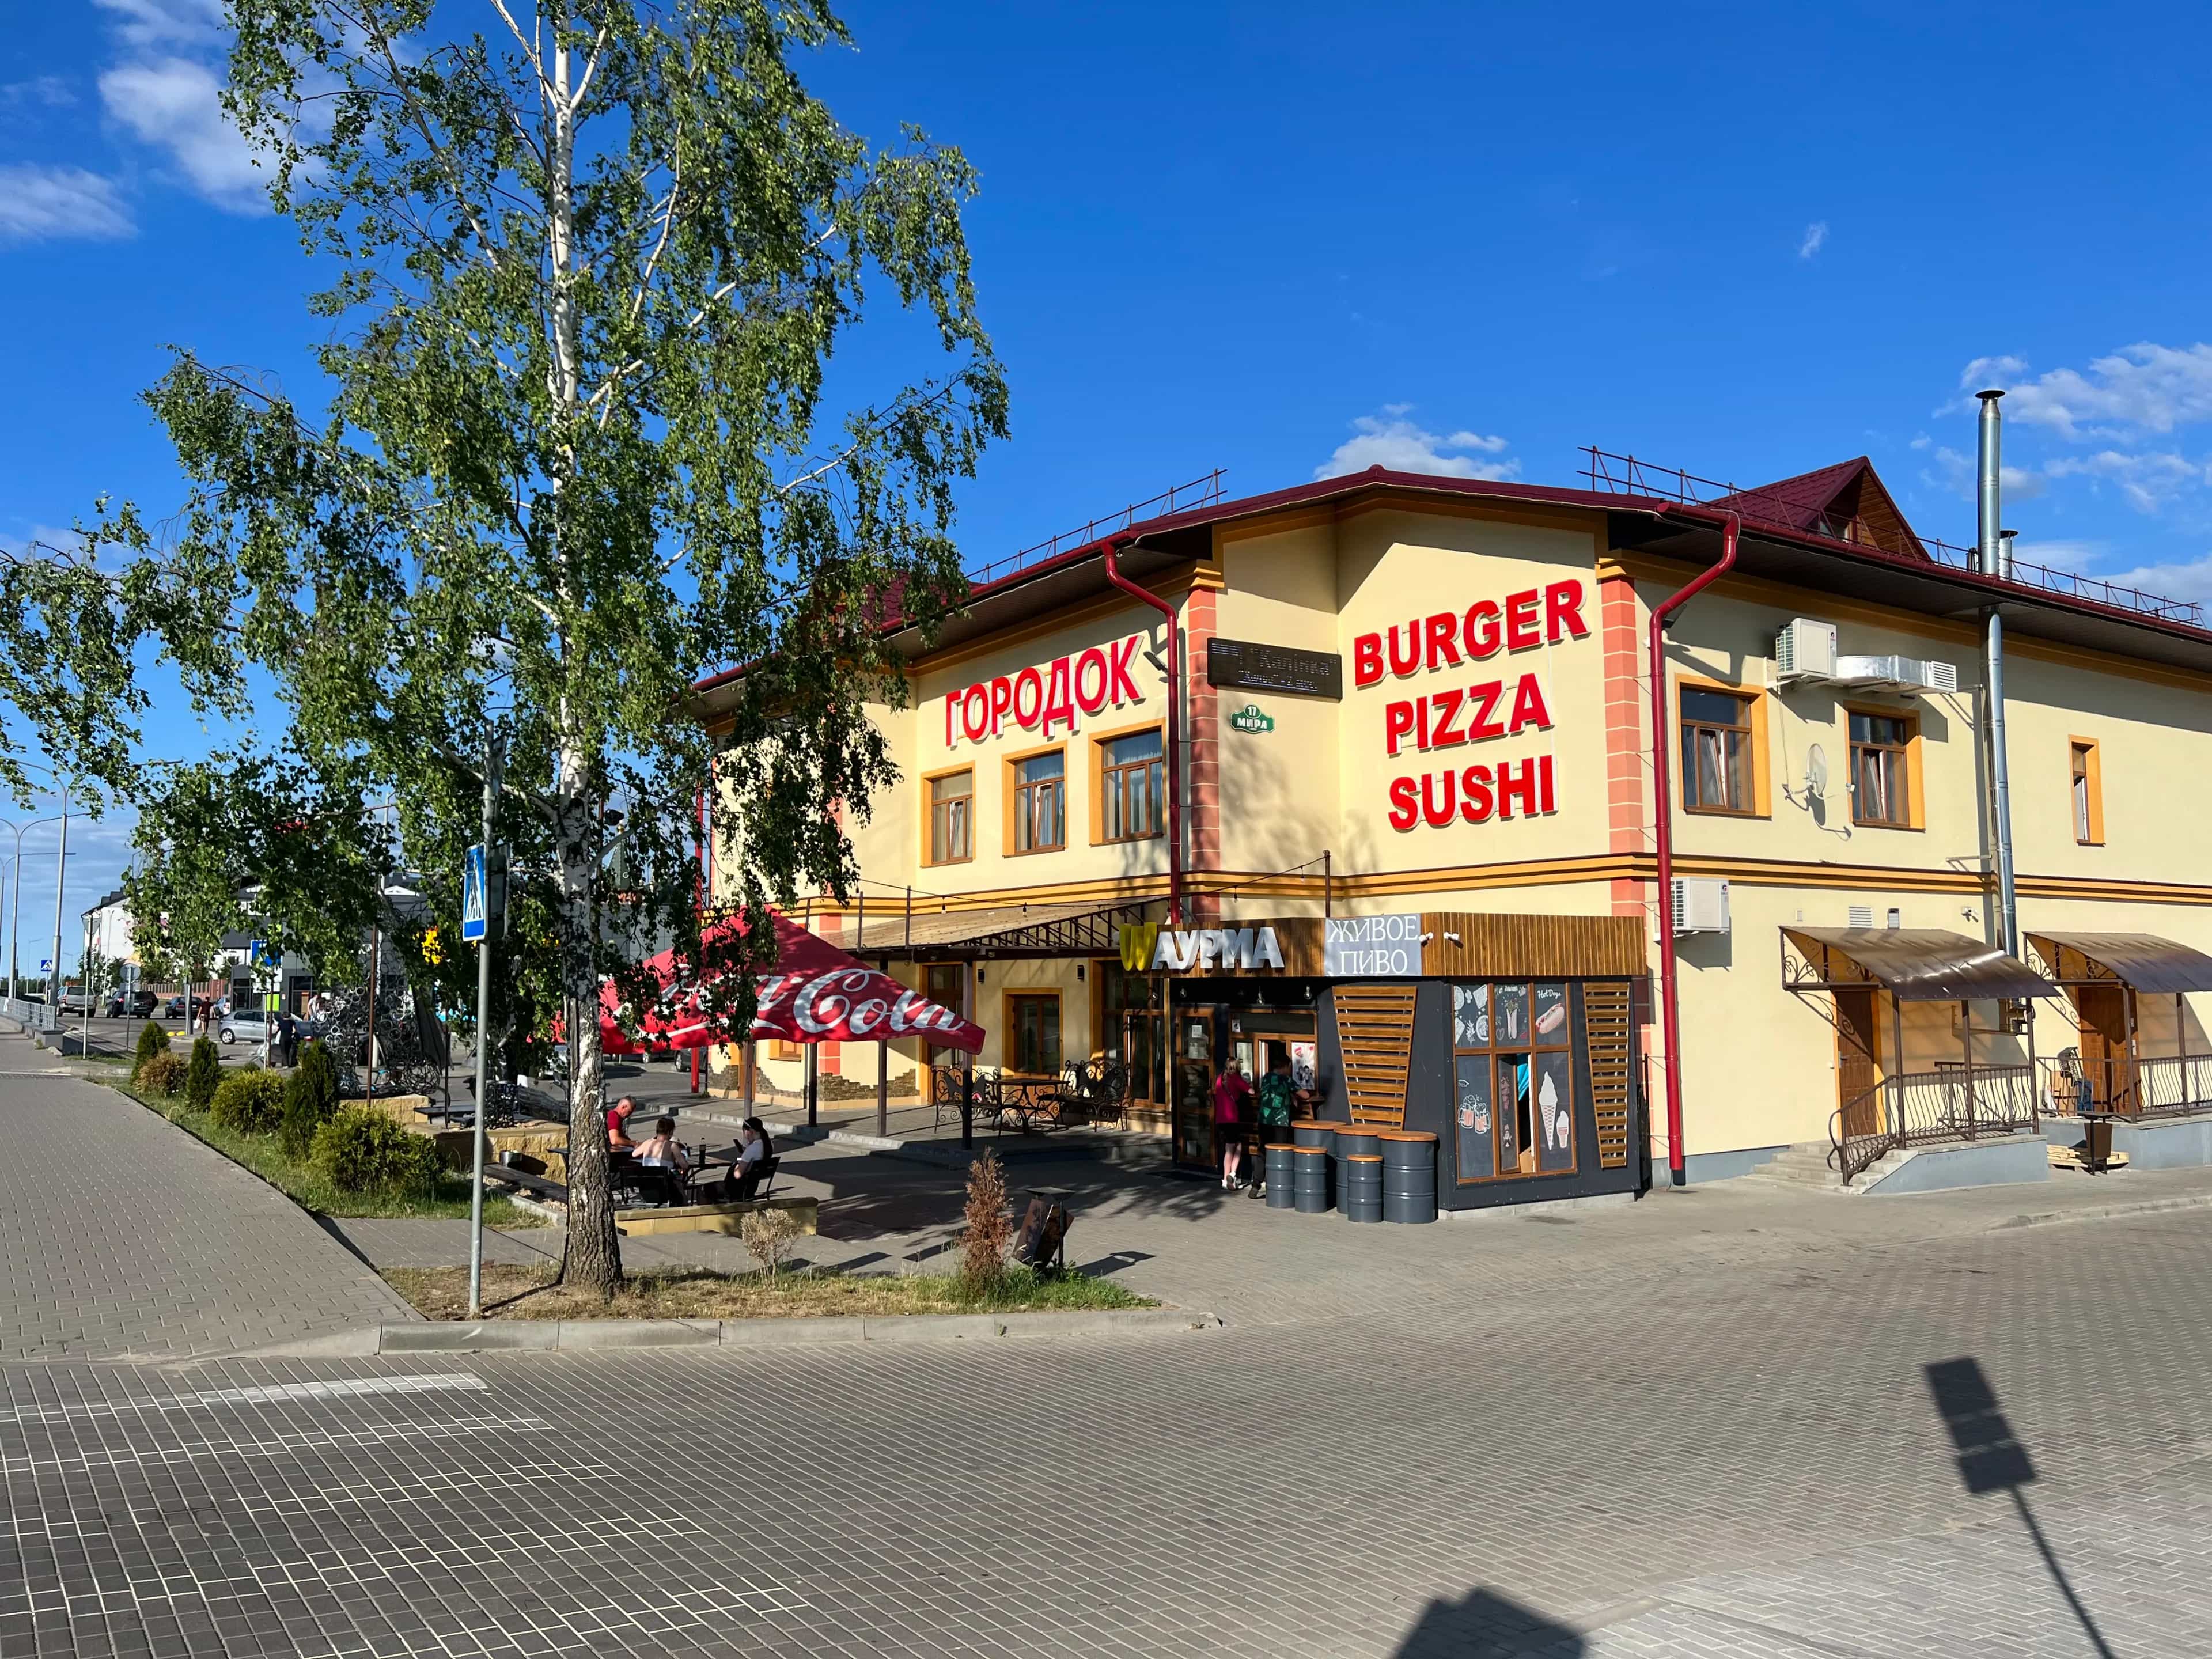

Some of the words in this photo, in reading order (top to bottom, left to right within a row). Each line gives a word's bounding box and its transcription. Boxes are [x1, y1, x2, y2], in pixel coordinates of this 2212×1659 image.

[1354, 579, 1590, 688] BURGER
[945, 635, 1142, 748] ГОРОДОК
[1247, 706, 1257, 717] 17
[1385, 672, 1553, 756] PIZZA
[1237, 717, 1267, 729] МИРА
[1388, 754, 1557, 831] SUSHI
[1327, 915, 1418, 943] ЖИВОЕ
[1339, 949, 1408, 974] ПИВО
